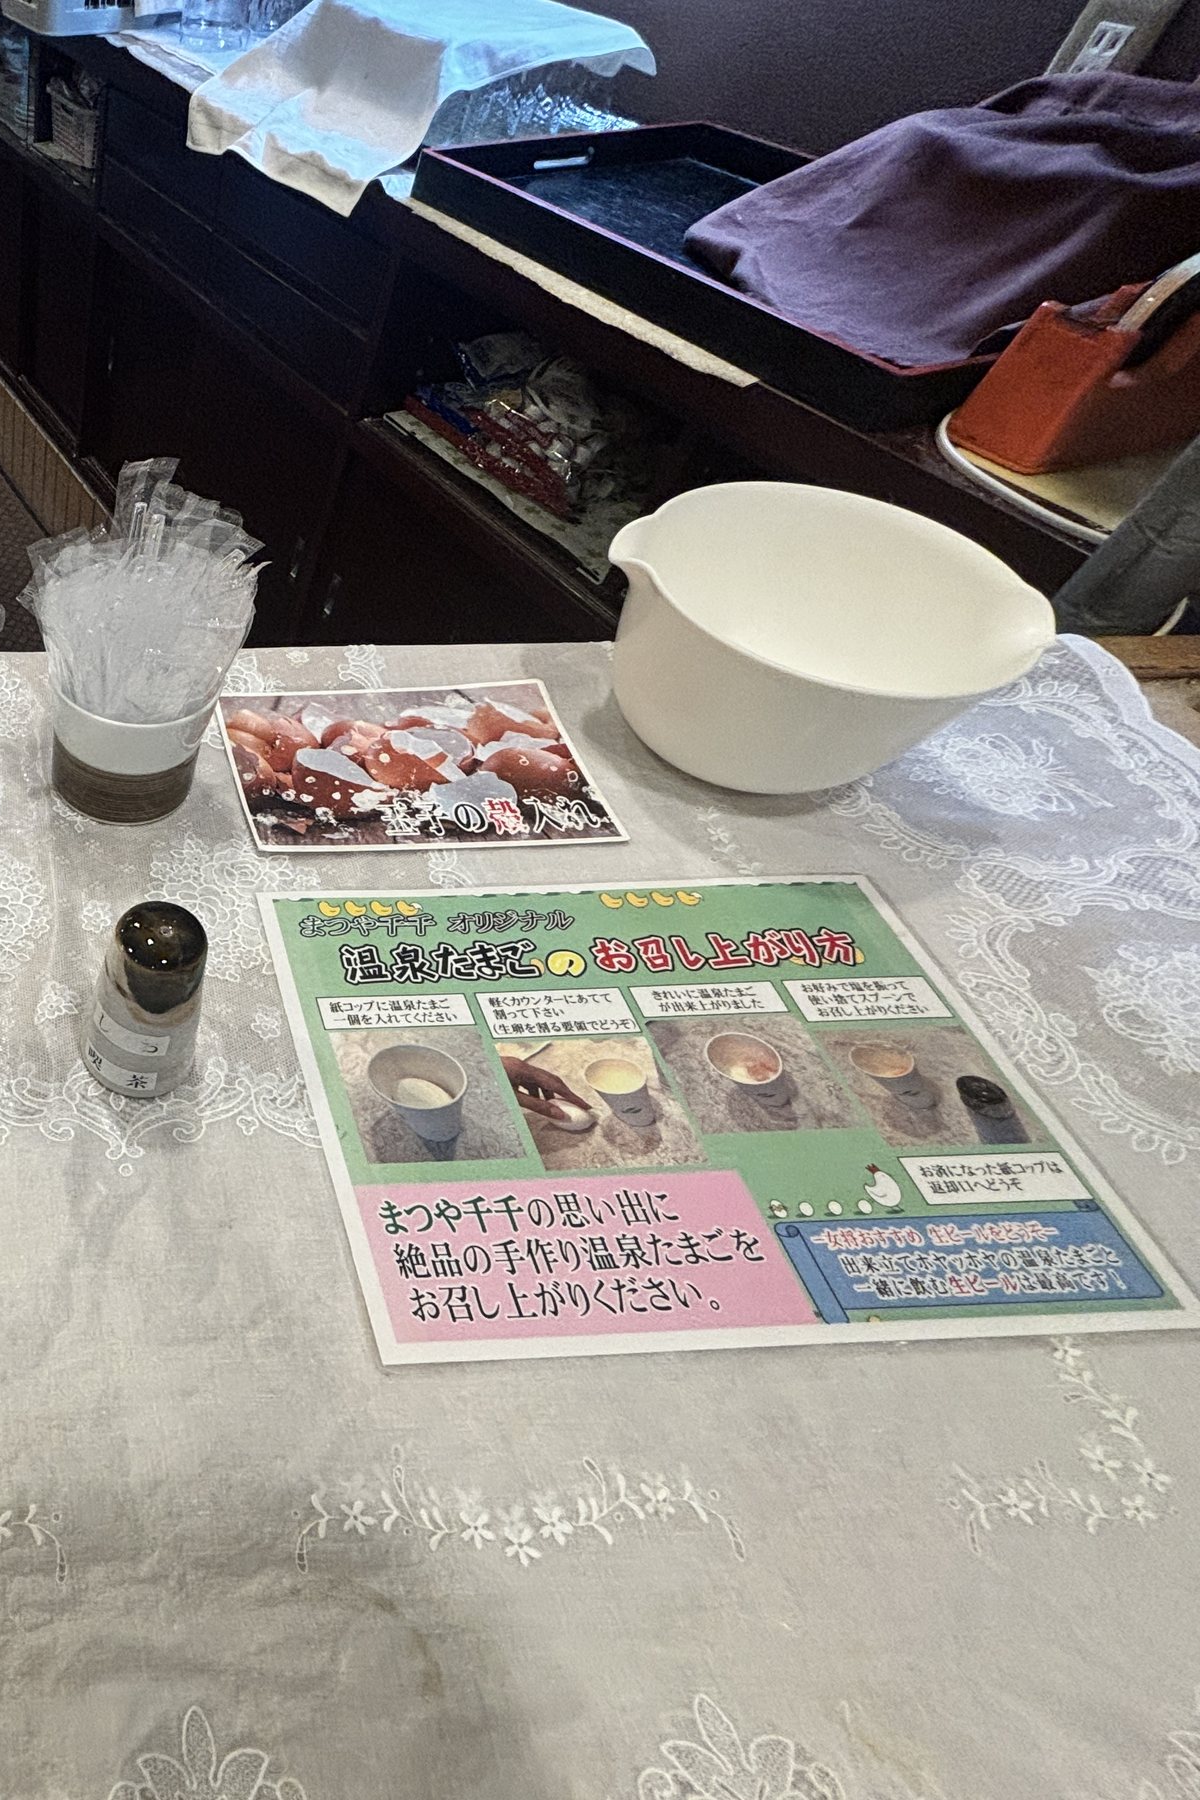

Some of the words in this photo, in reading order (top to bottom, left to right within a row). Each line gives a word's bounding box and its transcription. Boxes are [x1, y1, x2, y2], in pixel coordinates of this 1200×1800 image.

[448, 910, 575, 933] オリジナル
[488, 992, 612, 1008] 軽くカウンターにあてて
[651, 986, 757, 1001] きれいに温泉たまご
[329, 998, 451, 1013] 紙コップに温泉たまご
[658, 998, 765, 1012] が出来上がりました
[816, 1004, 930, 1018] お召し上がりください
[334, 1011, 458, 1026] 一個を入れてください
[493, 1007, 565, 1020] 割って下さい
[378, 1188, 680, 1235] まつや千千の思い出に
[393, 1227, 766, 1280] 絶品の手作り温泉たまごを
[409, 1276, 722, 1323] お召し上がりください。
